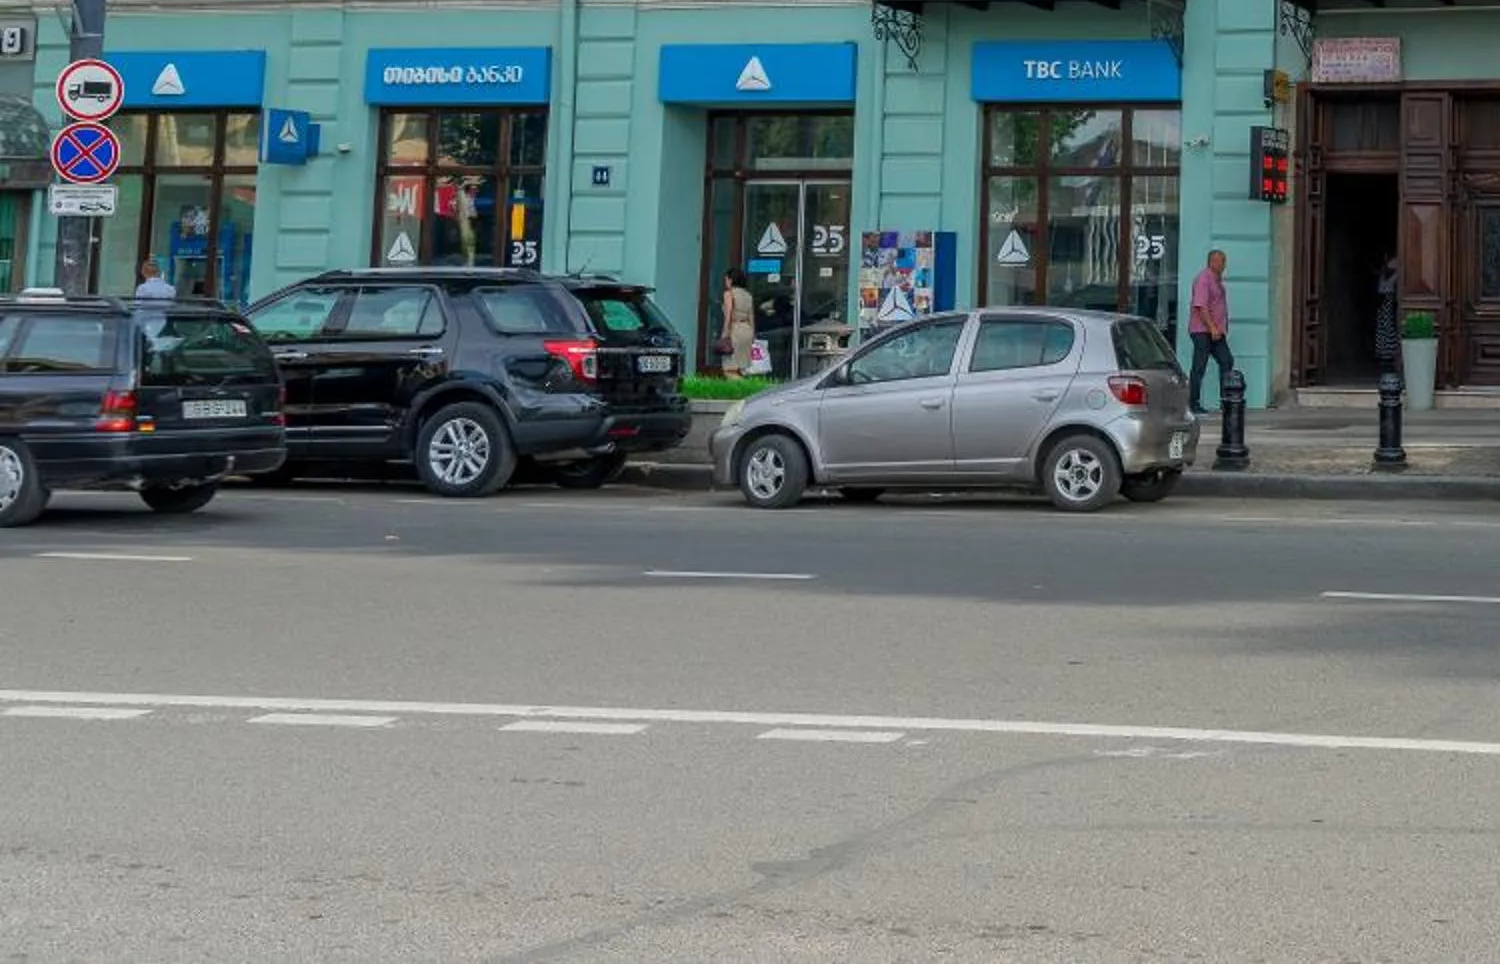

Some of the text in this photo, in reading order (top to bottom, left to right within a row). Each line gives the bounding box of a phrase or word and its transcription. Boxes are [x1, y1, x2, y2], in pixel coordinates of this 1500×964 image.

[466, 65, 523, 84] ბანკი
[1023, 59, 1123, 78] TBC BANK
[812, 225, 845, 254] 25
[511, 241, 538, 265] 25
